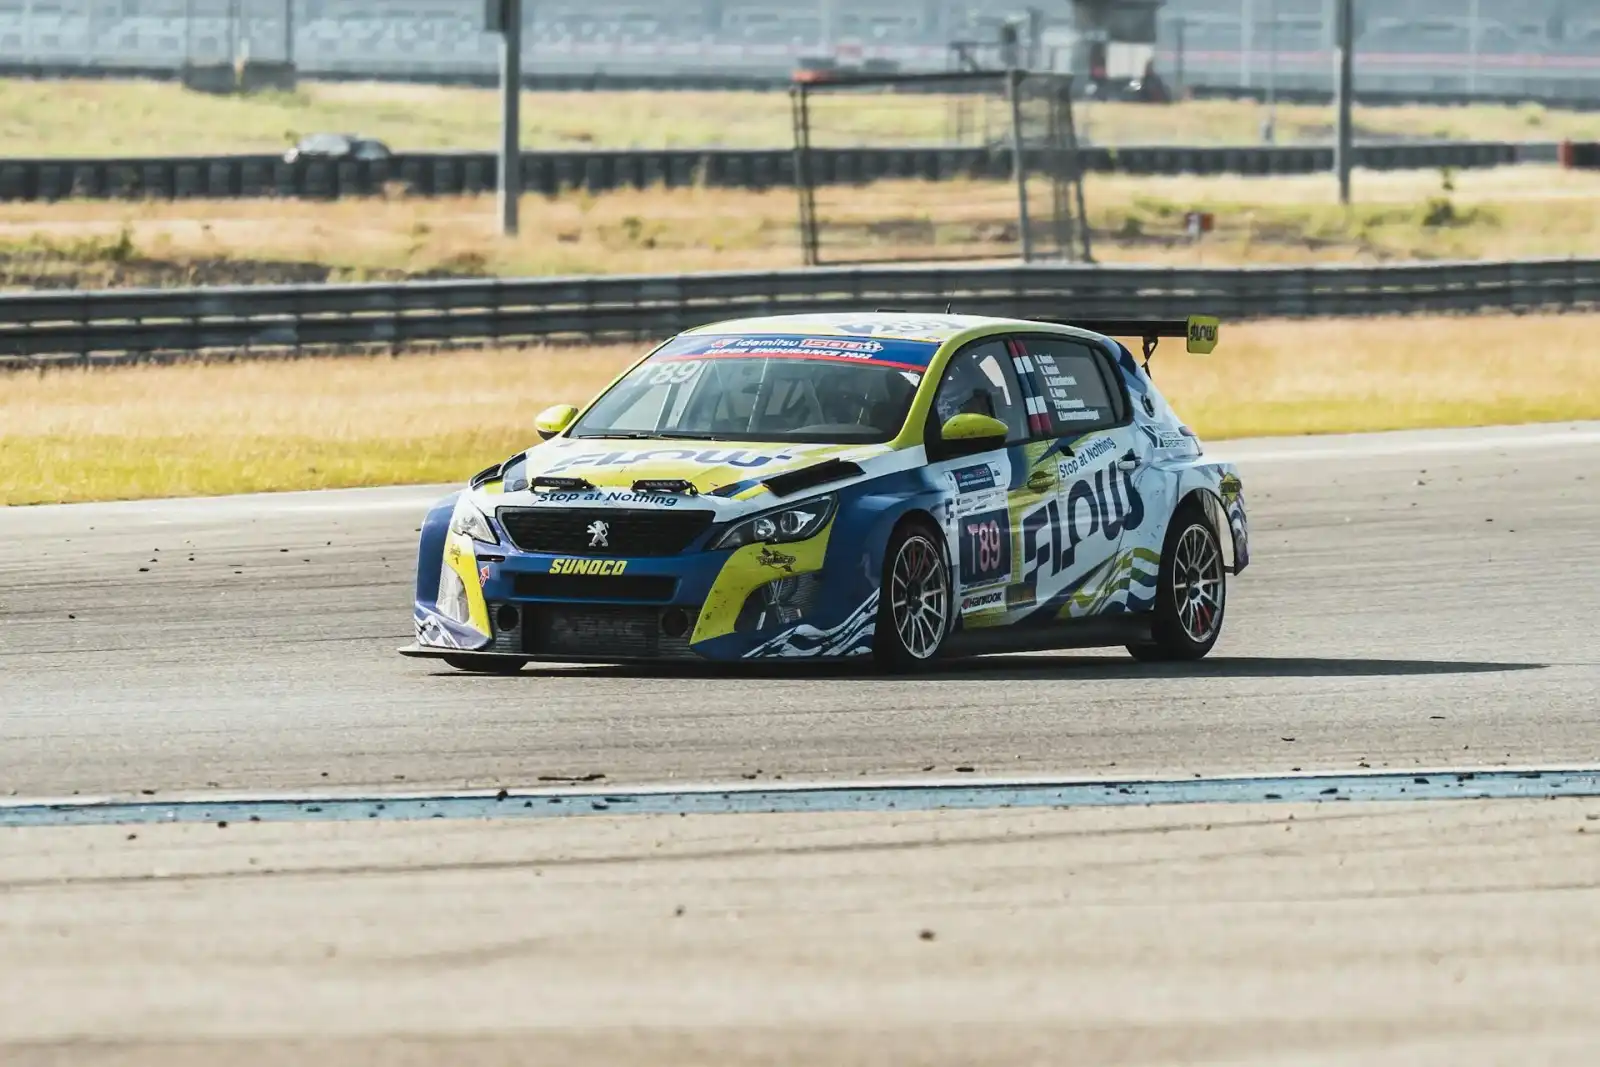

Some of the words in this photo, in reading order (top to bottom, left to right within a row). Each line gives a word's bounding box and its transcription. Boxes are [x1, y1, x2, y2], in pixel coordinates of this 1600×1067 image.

[735, 338, 799, 347] idemitsu
[803, 339, 862, 350] 1500
[749, 348, 839, 358] ENDURANCE
[633, 360, 702, 385] T89
[1059, 459, 1078, 479] Stop
[1078, 451, 1088, 467] at
[1085, 436, 1117, 461] Nothing
[538, 491, 579, 503] Stop
[584, 492, 602, 502] at
[606, 491, 678, 507] Nothing
[967, 520, 1001, 575] T89
[549, 558, 628, 575] SUNOCO
